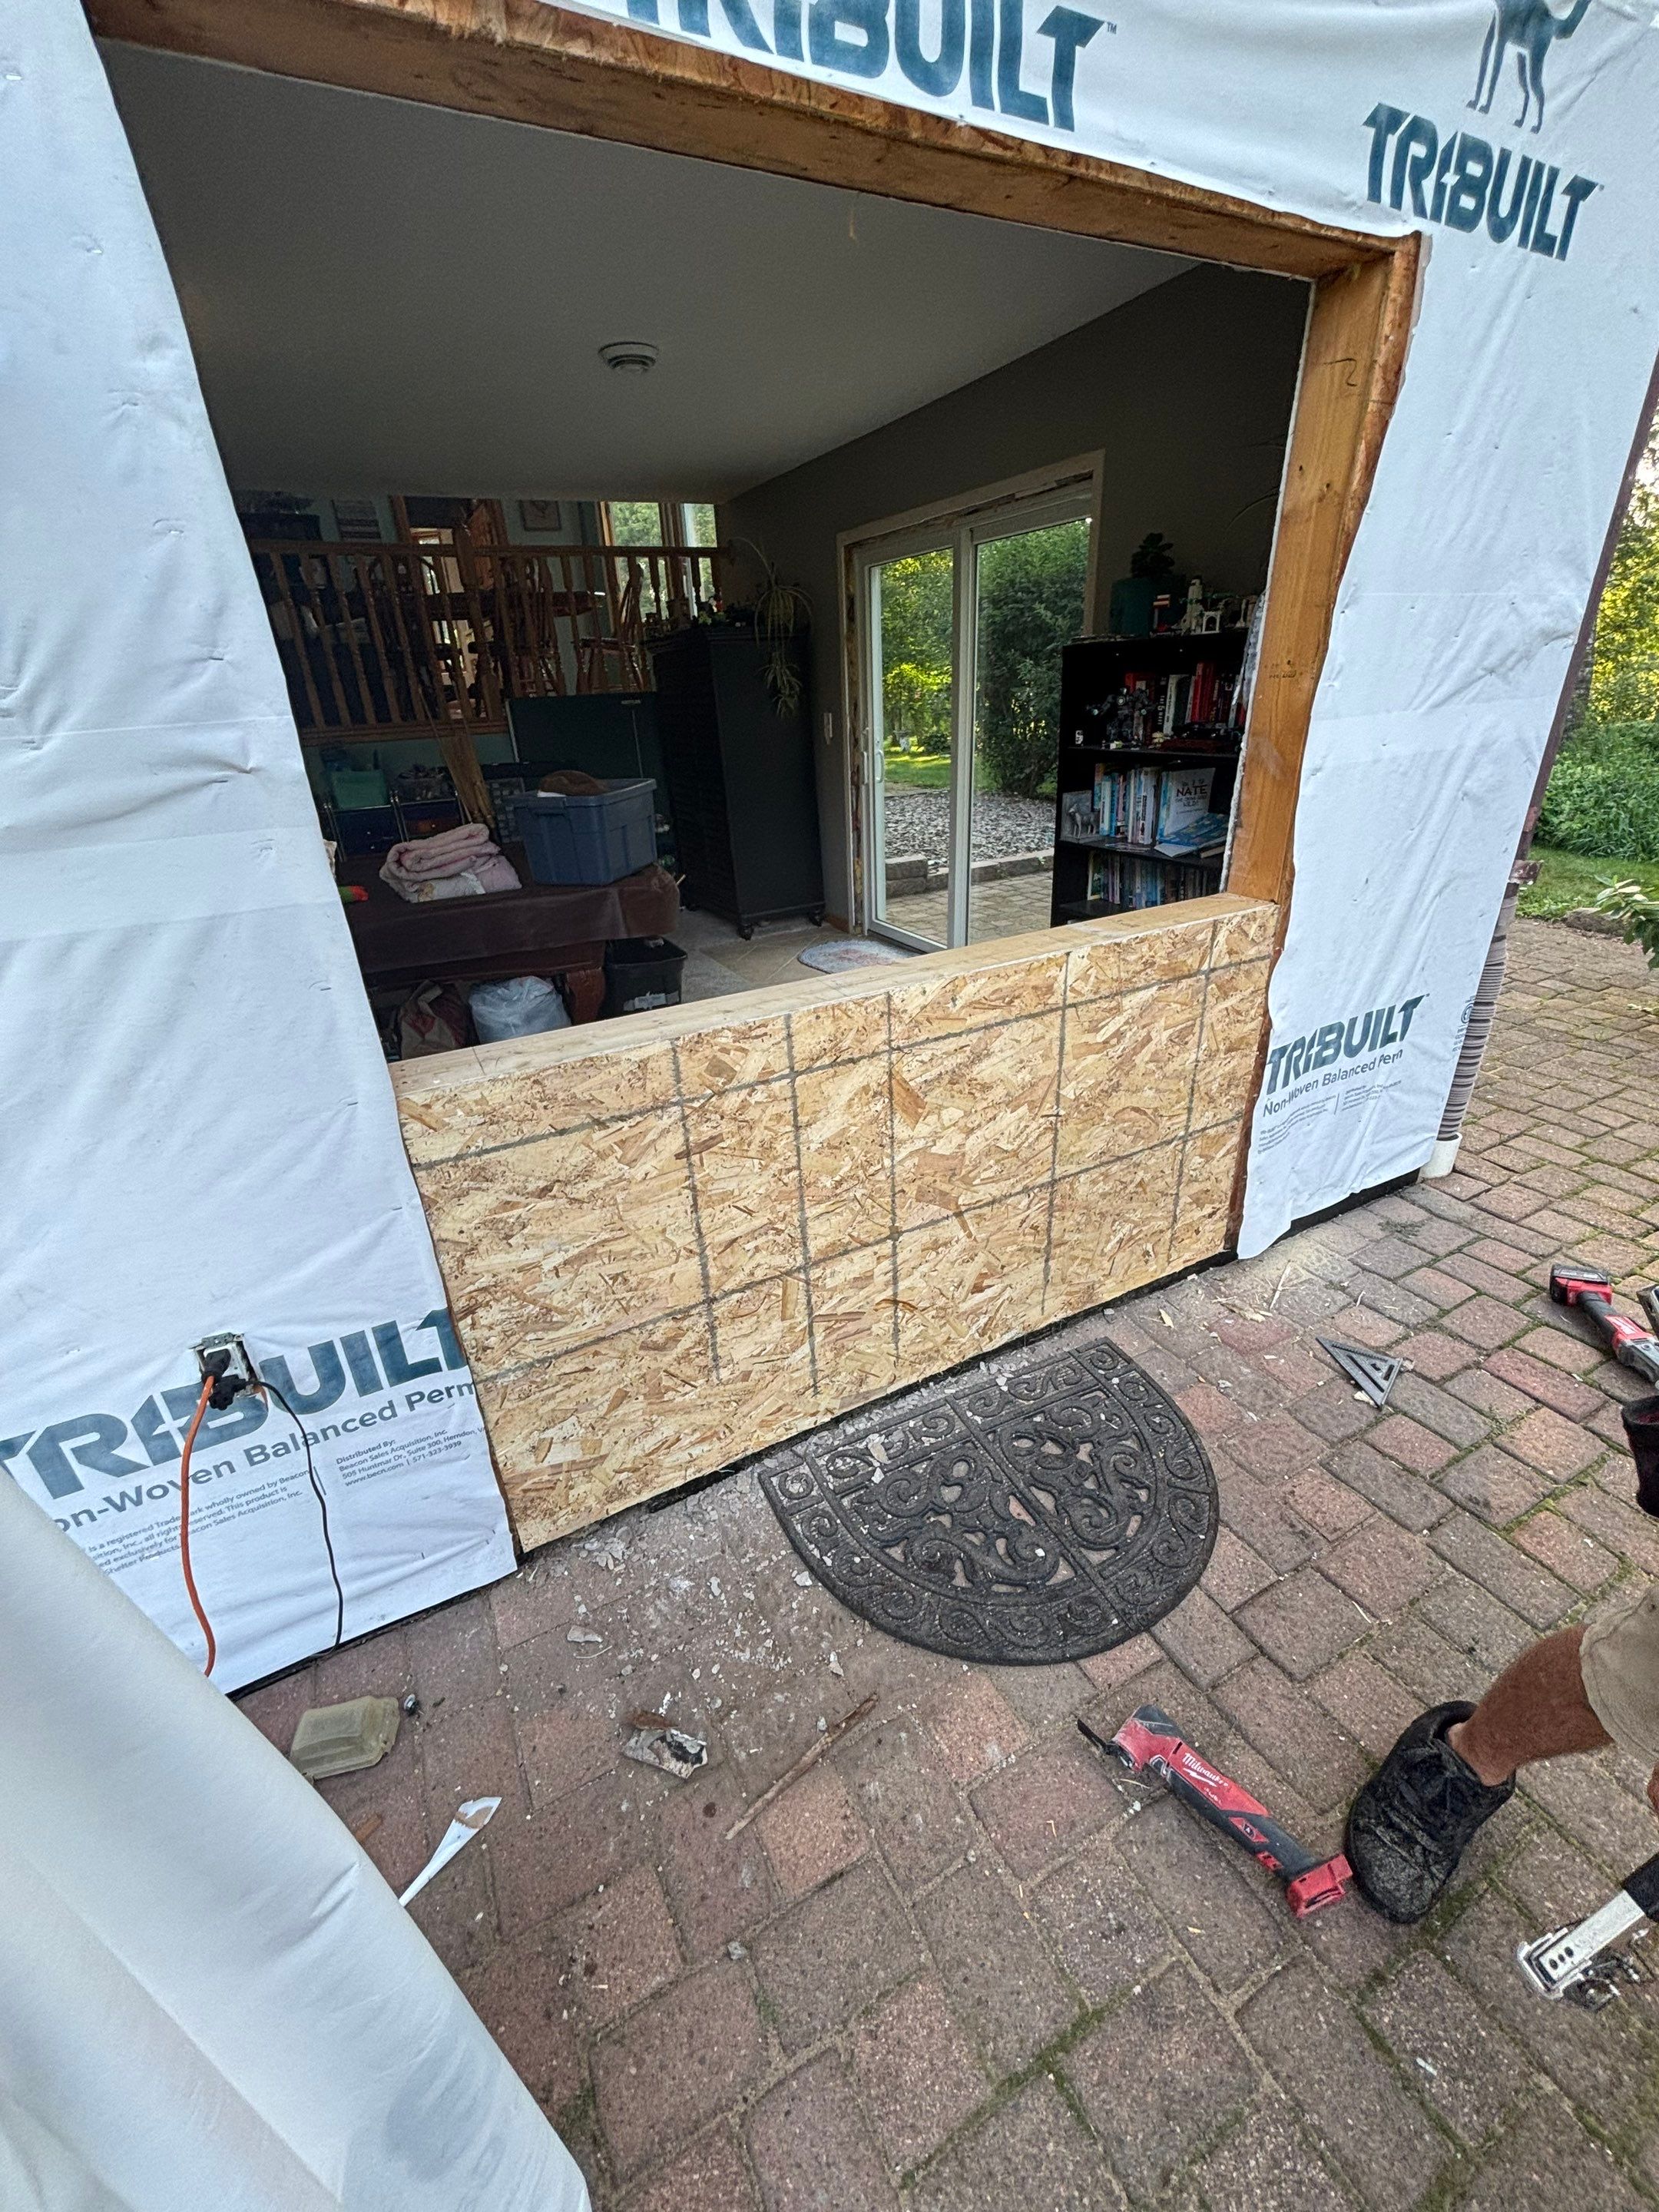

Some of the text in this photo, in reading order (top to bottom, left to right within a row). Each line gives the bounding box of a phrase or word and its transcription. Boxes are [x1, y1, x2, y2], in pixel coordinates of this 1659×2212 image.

[628, 0, 1105, 131] BUILT
[1363, 102, 1598, 261] TRIBUILT
[1177, 784, 1207, 796] NATE
[1266, 994, 1426, 1095] TRIBUILT
[1322, 1058, 1376, 1087] Balanced
[243, 1400, 398, 1467] Balanced
[336, 1443, 381, 1465] Distributed
[339, 1459, 369, 1472] Beacon
[369, 1451, 389, 1462] Sales
[390, 1434, 433, 1454] Acquisition,
[343, 1469, 357, 1480] 505
[358, 1459, 392, 1475] Huntmar
[406, 1445, 426, 1456] Suite
[107, 1525, 154, 1545] registered
[154, 1507, 203, 1528] Tradeark
[205, 1496, 234, 1510] wholly
[236, 1485, 266, 1499] owned
[267, 1479, 278, 1488] by
[279, 1470, 310, 1484] Beacon
[225, 1502, 243, 1512] This
[245, 1490, 279, 1507] product
[114, 1539, 163, 1561] exclusively
[214, 1514, 236, 1526] Sales
[238, 1496, 287, 1517] Acquisition,
